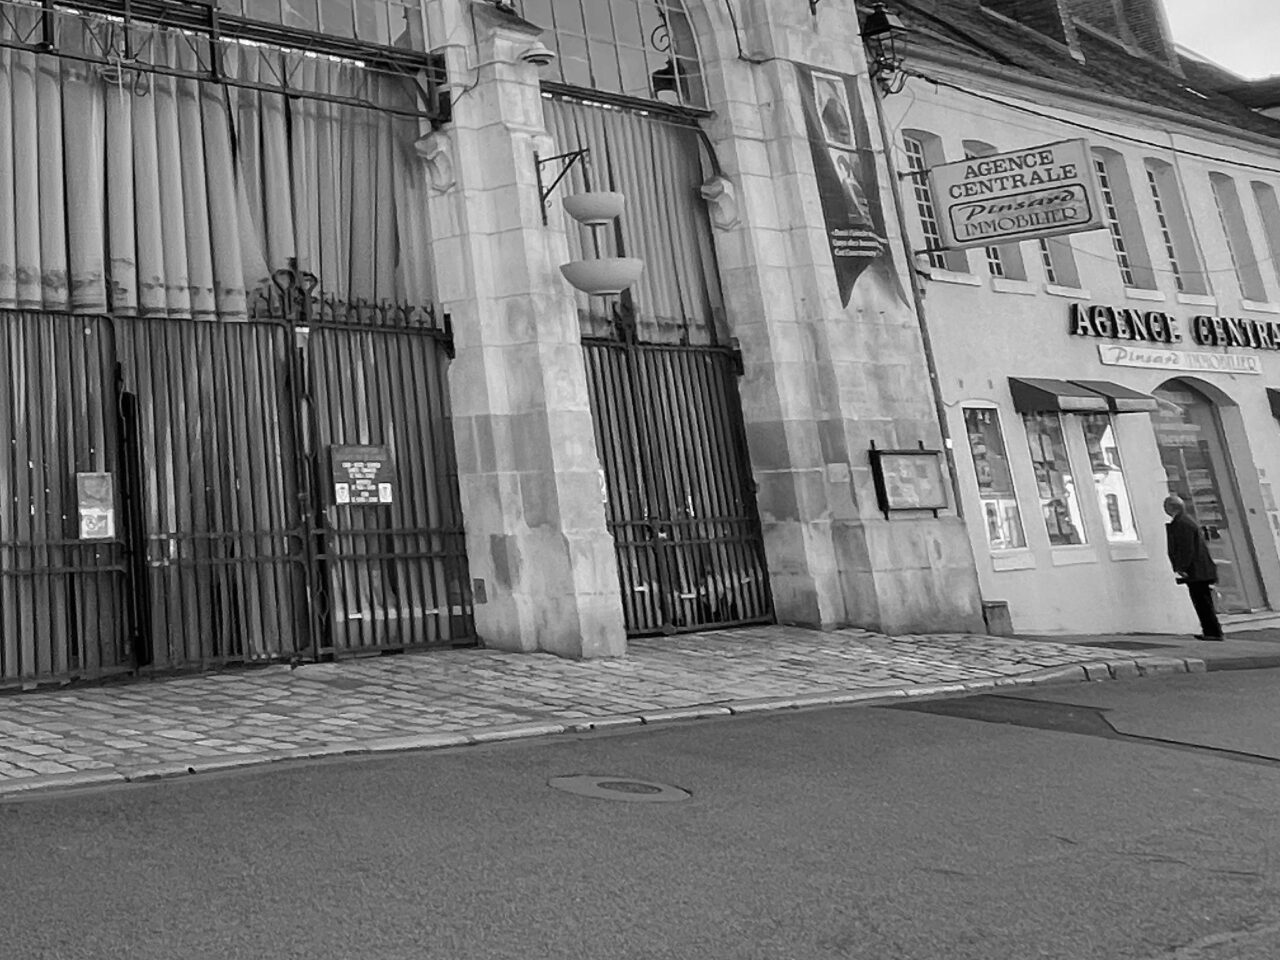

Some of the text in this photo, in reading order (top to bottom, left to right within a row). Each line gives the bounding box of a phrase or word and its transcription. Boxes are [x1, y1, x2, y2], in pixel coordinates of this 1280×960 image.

[964, 149, 1055, 180] AGENCE
[948, 164, 1078, 200] CENTRALE
[958, 189, 1075, 221] Pinsard
[965, 207, 1078, 237] IMMOBILIER
[1069, 303, 1183, 343] AGENCE
